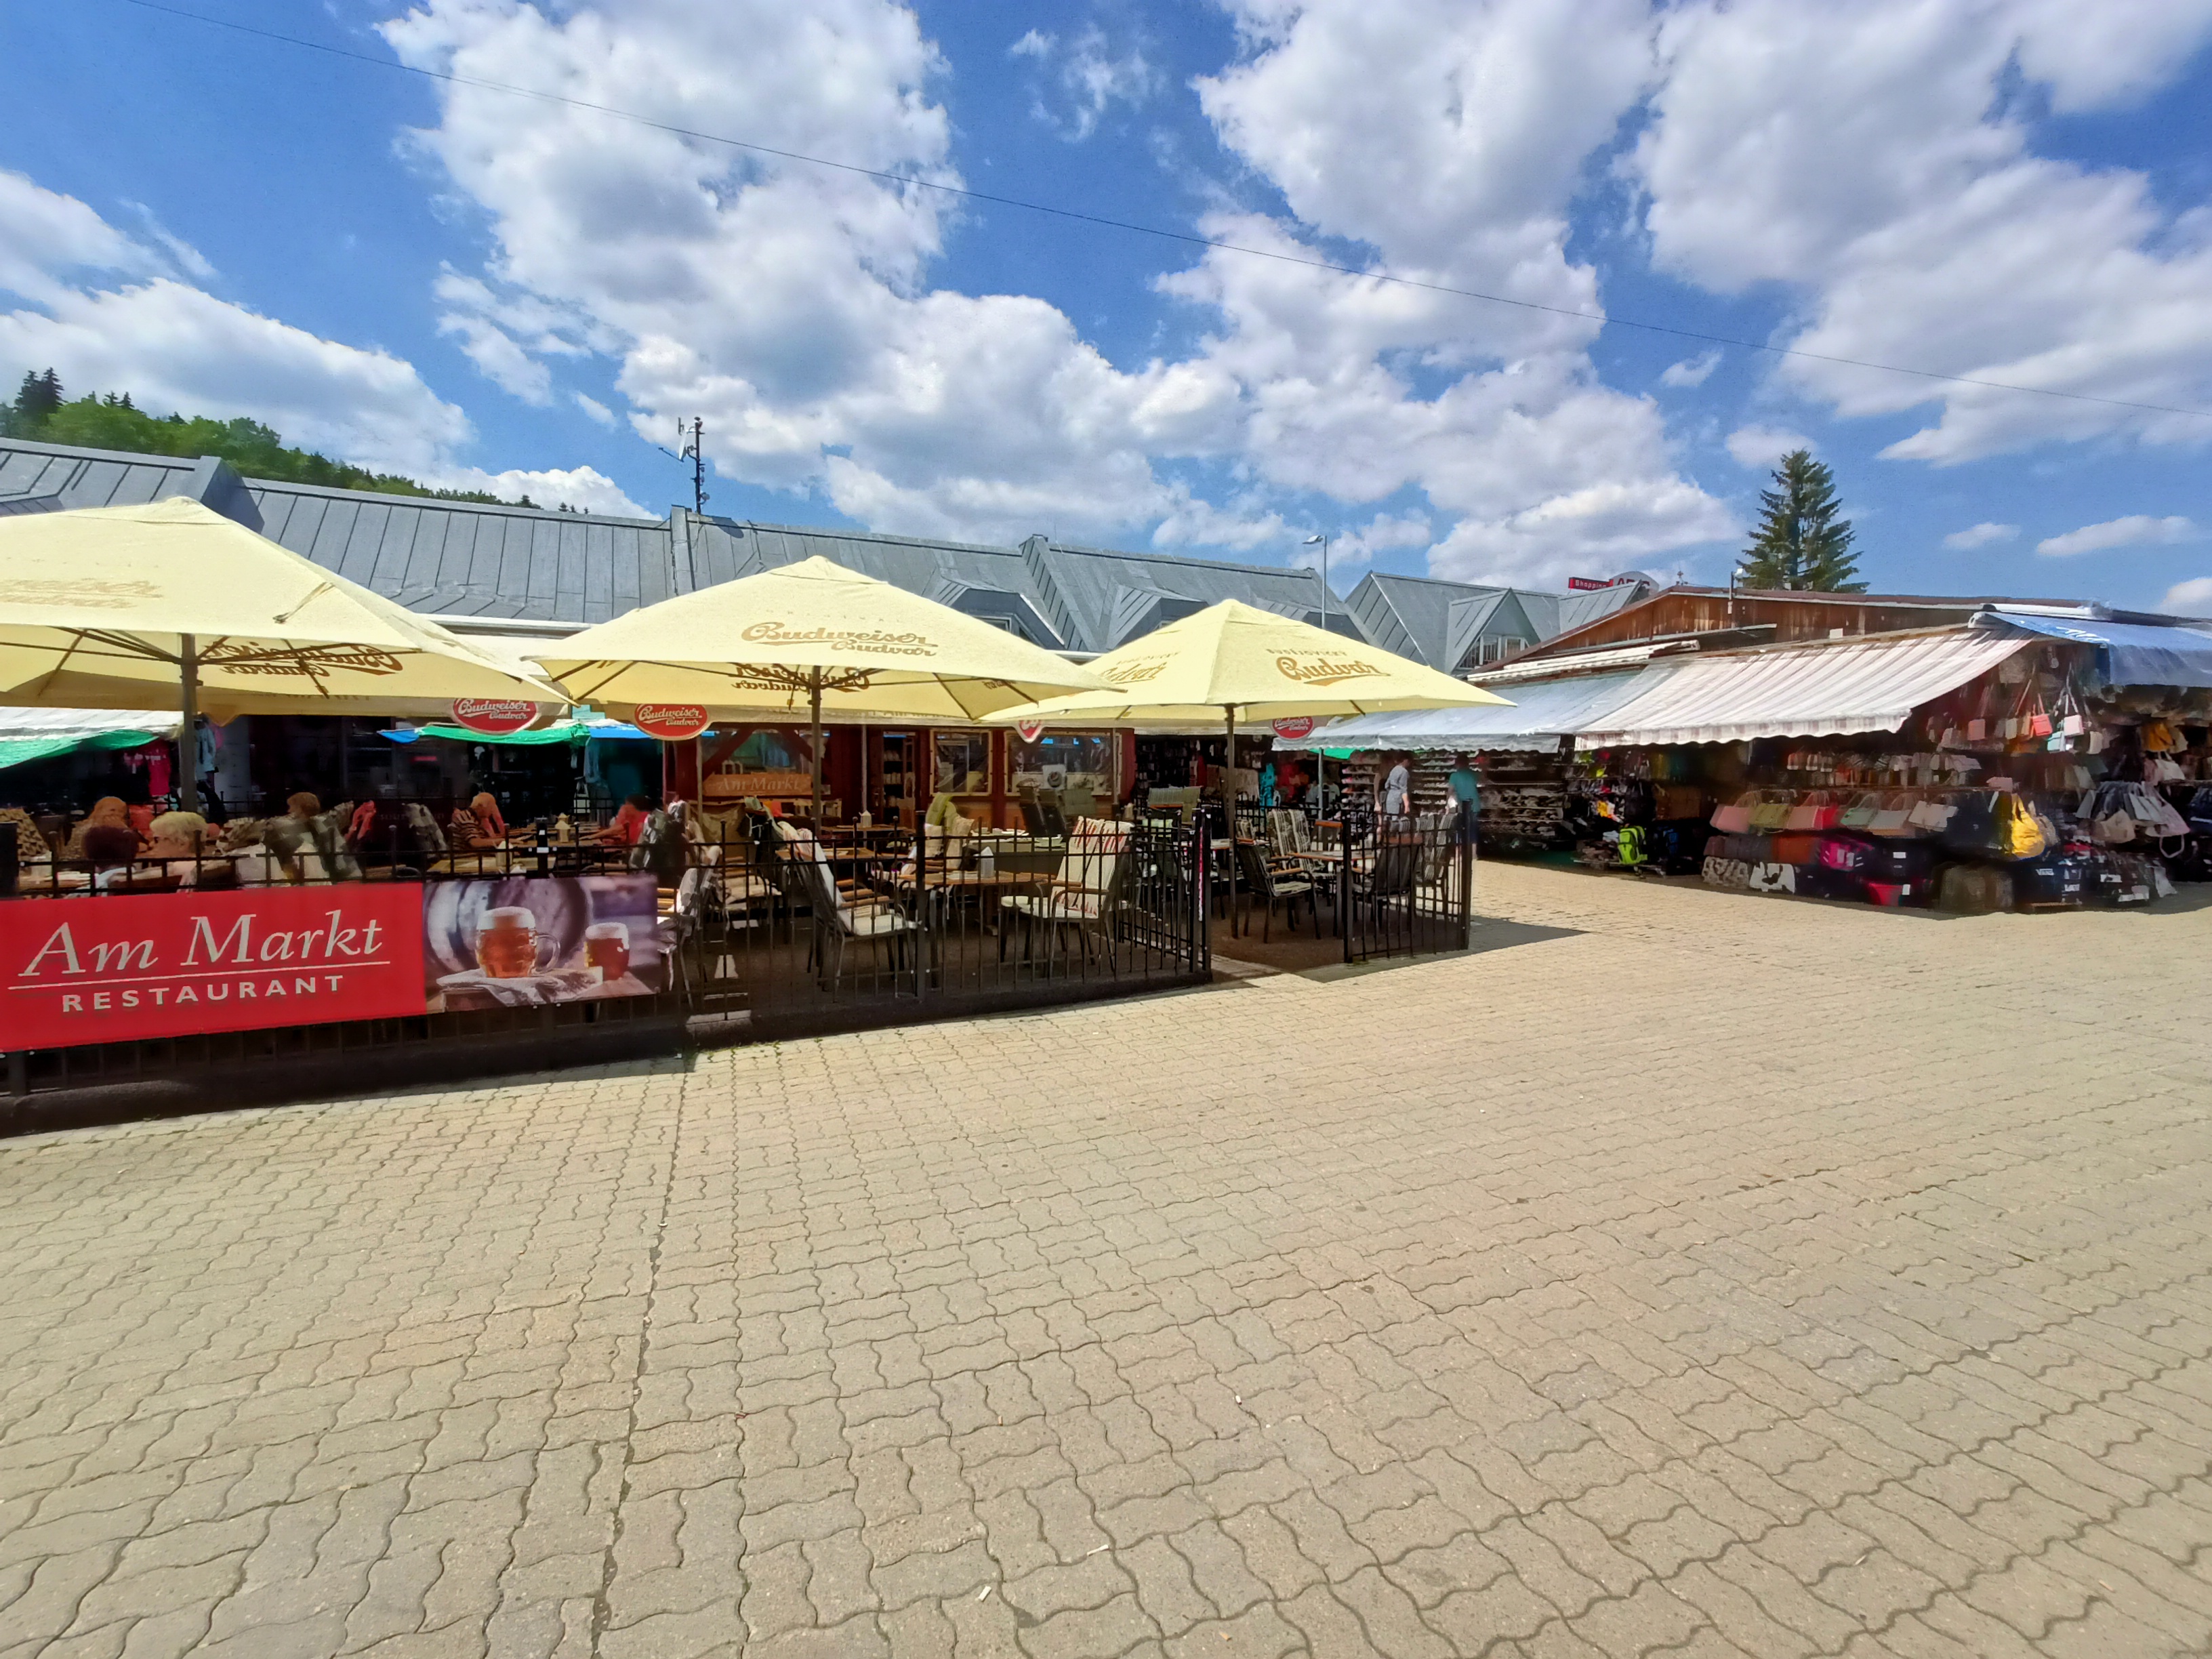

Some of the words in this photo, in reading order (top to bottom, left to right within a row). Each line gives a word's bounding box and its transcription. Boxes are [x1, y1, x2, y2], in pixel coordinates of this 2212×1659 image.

[741, 621, 939, 644] Budweiser
[831, 639, 937, 657] Budvar
[1276, 657, 1391, 680] Budvar
[457, 699, 531, 715] Budweiser
[638, 705, 702, 721] Budweiser
[489, 712, 528, 720] Budvar
[665, 718, 699, 726] Budvar
[718, 778, 745, 791] Am
[750, 776, 798, 791] Markt
[18, 922, 158, 977] Am
[180, 909, 382, 966] Markt
[62, 976, 343, 1012] RESTAURANT
